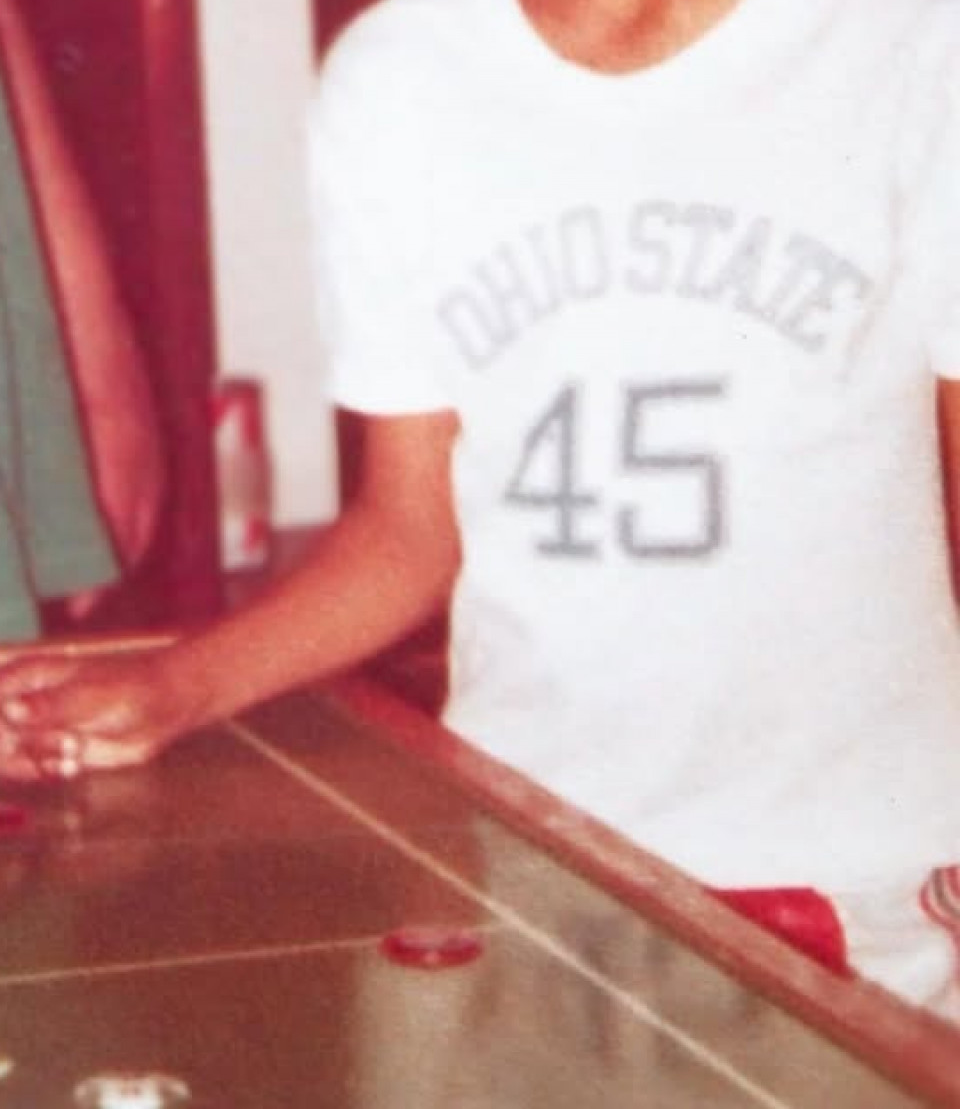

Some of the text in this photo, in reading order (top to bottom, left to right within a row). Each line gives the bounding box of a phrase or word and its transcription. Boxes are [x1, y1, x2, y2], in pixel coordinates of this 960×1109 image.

[438, 199, 875, 370] OHIO STATE
[501, 378, 729, 560] 45
